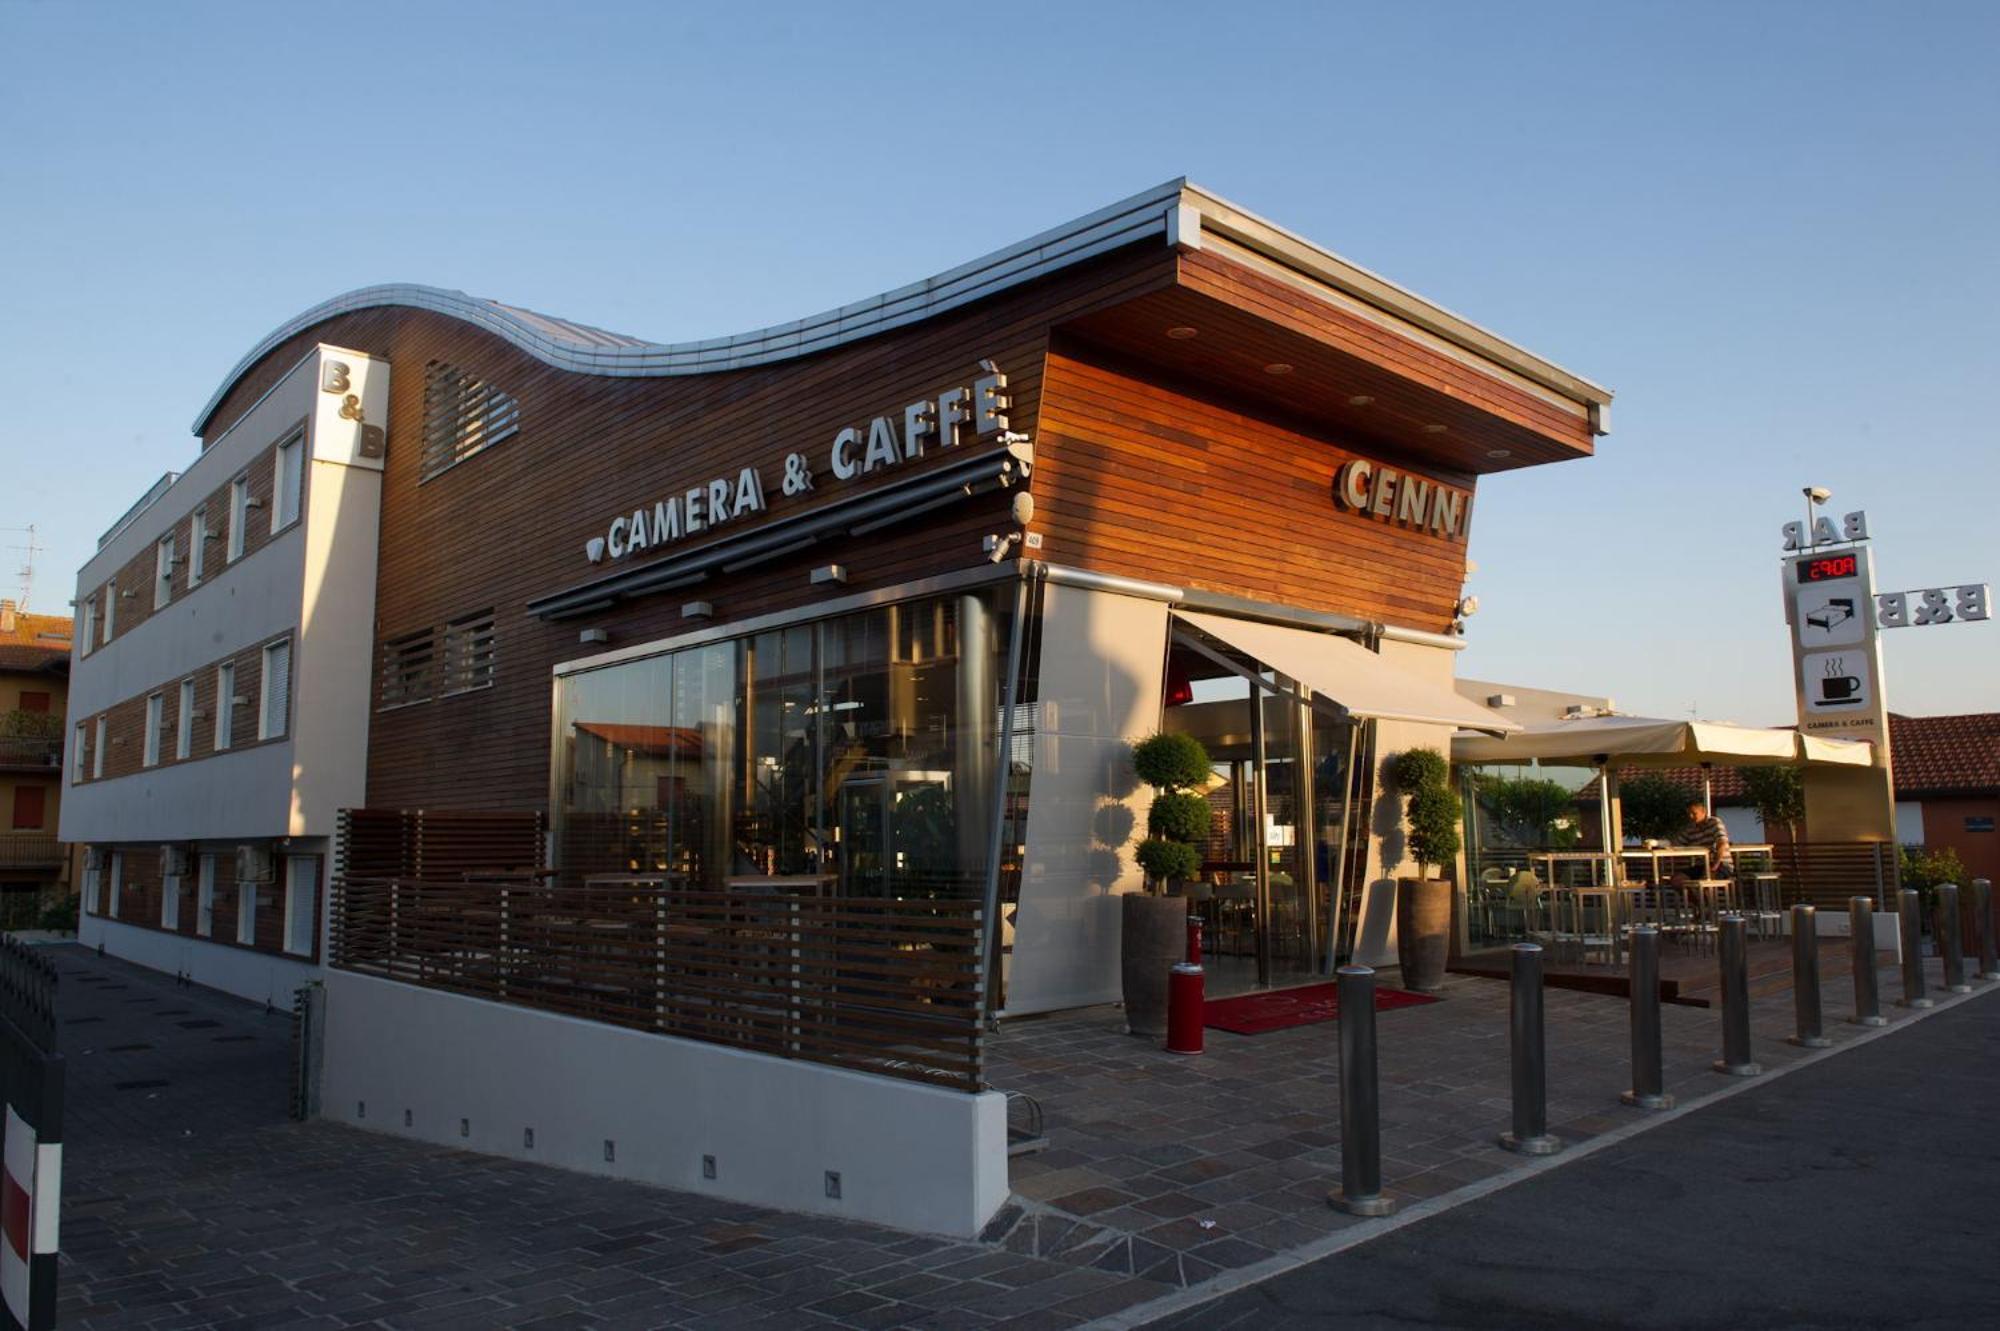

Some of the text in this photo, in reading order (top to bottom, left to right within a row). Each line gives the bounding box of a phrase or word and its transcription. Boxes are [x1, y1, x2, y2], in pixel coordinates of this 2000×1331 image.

[607, 359, 1012, 560] CAMERA & CAFFÈ
